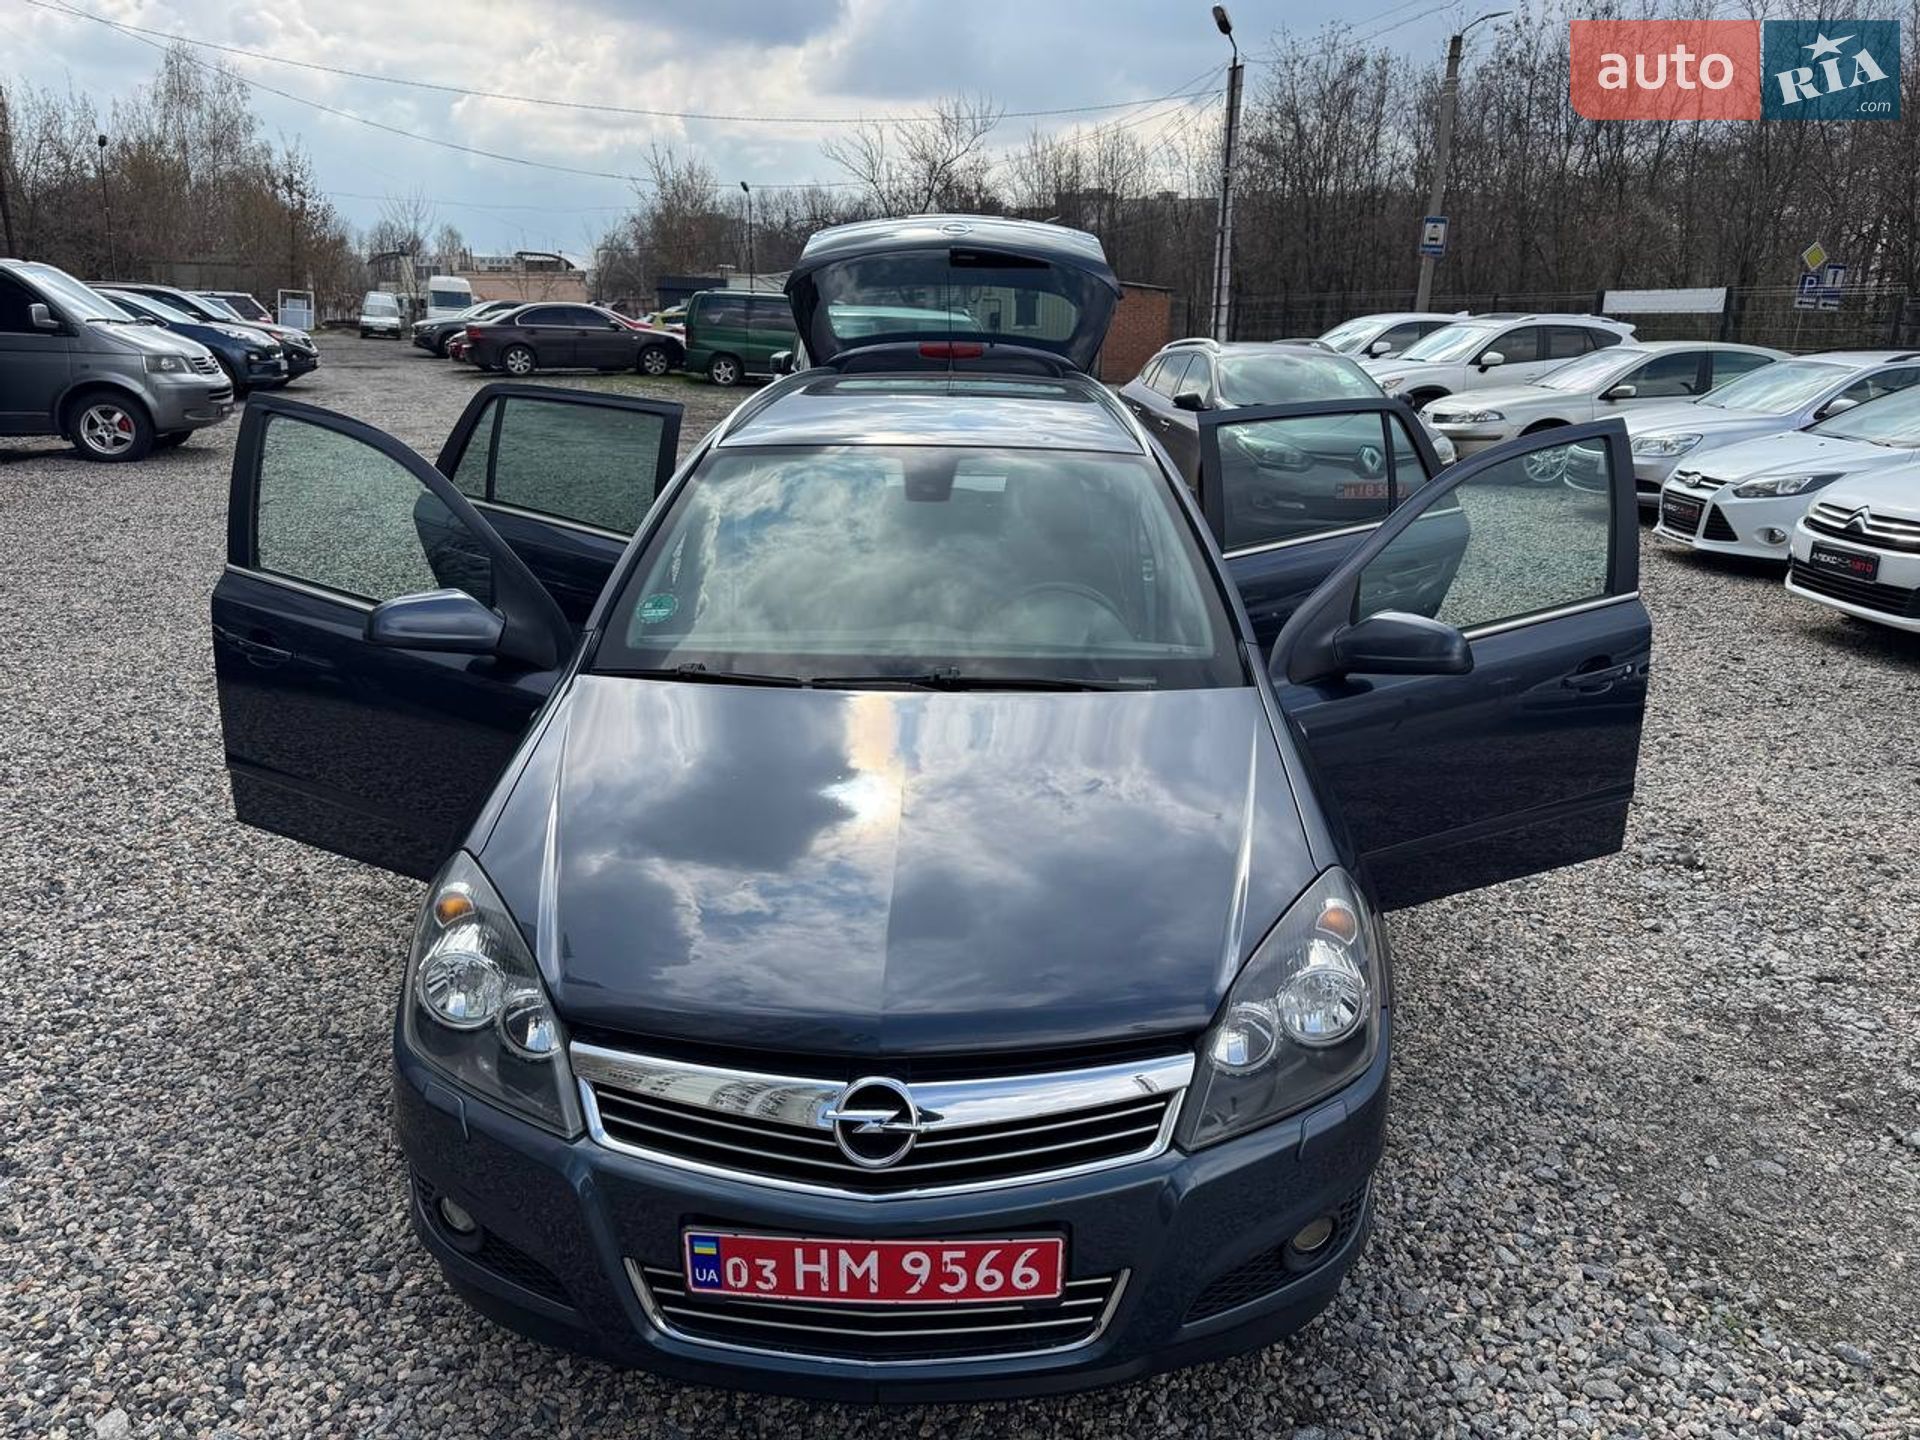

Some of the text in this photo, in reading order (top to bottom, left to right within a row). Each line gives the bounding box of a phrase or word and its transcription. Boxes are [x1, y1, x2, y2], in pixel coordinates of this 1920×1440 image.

[1803, 276, 1817, 294] P
[695, 1268, 718, 1283] UA
[726, 1248, 1040, 1294] 03 HM 9566
